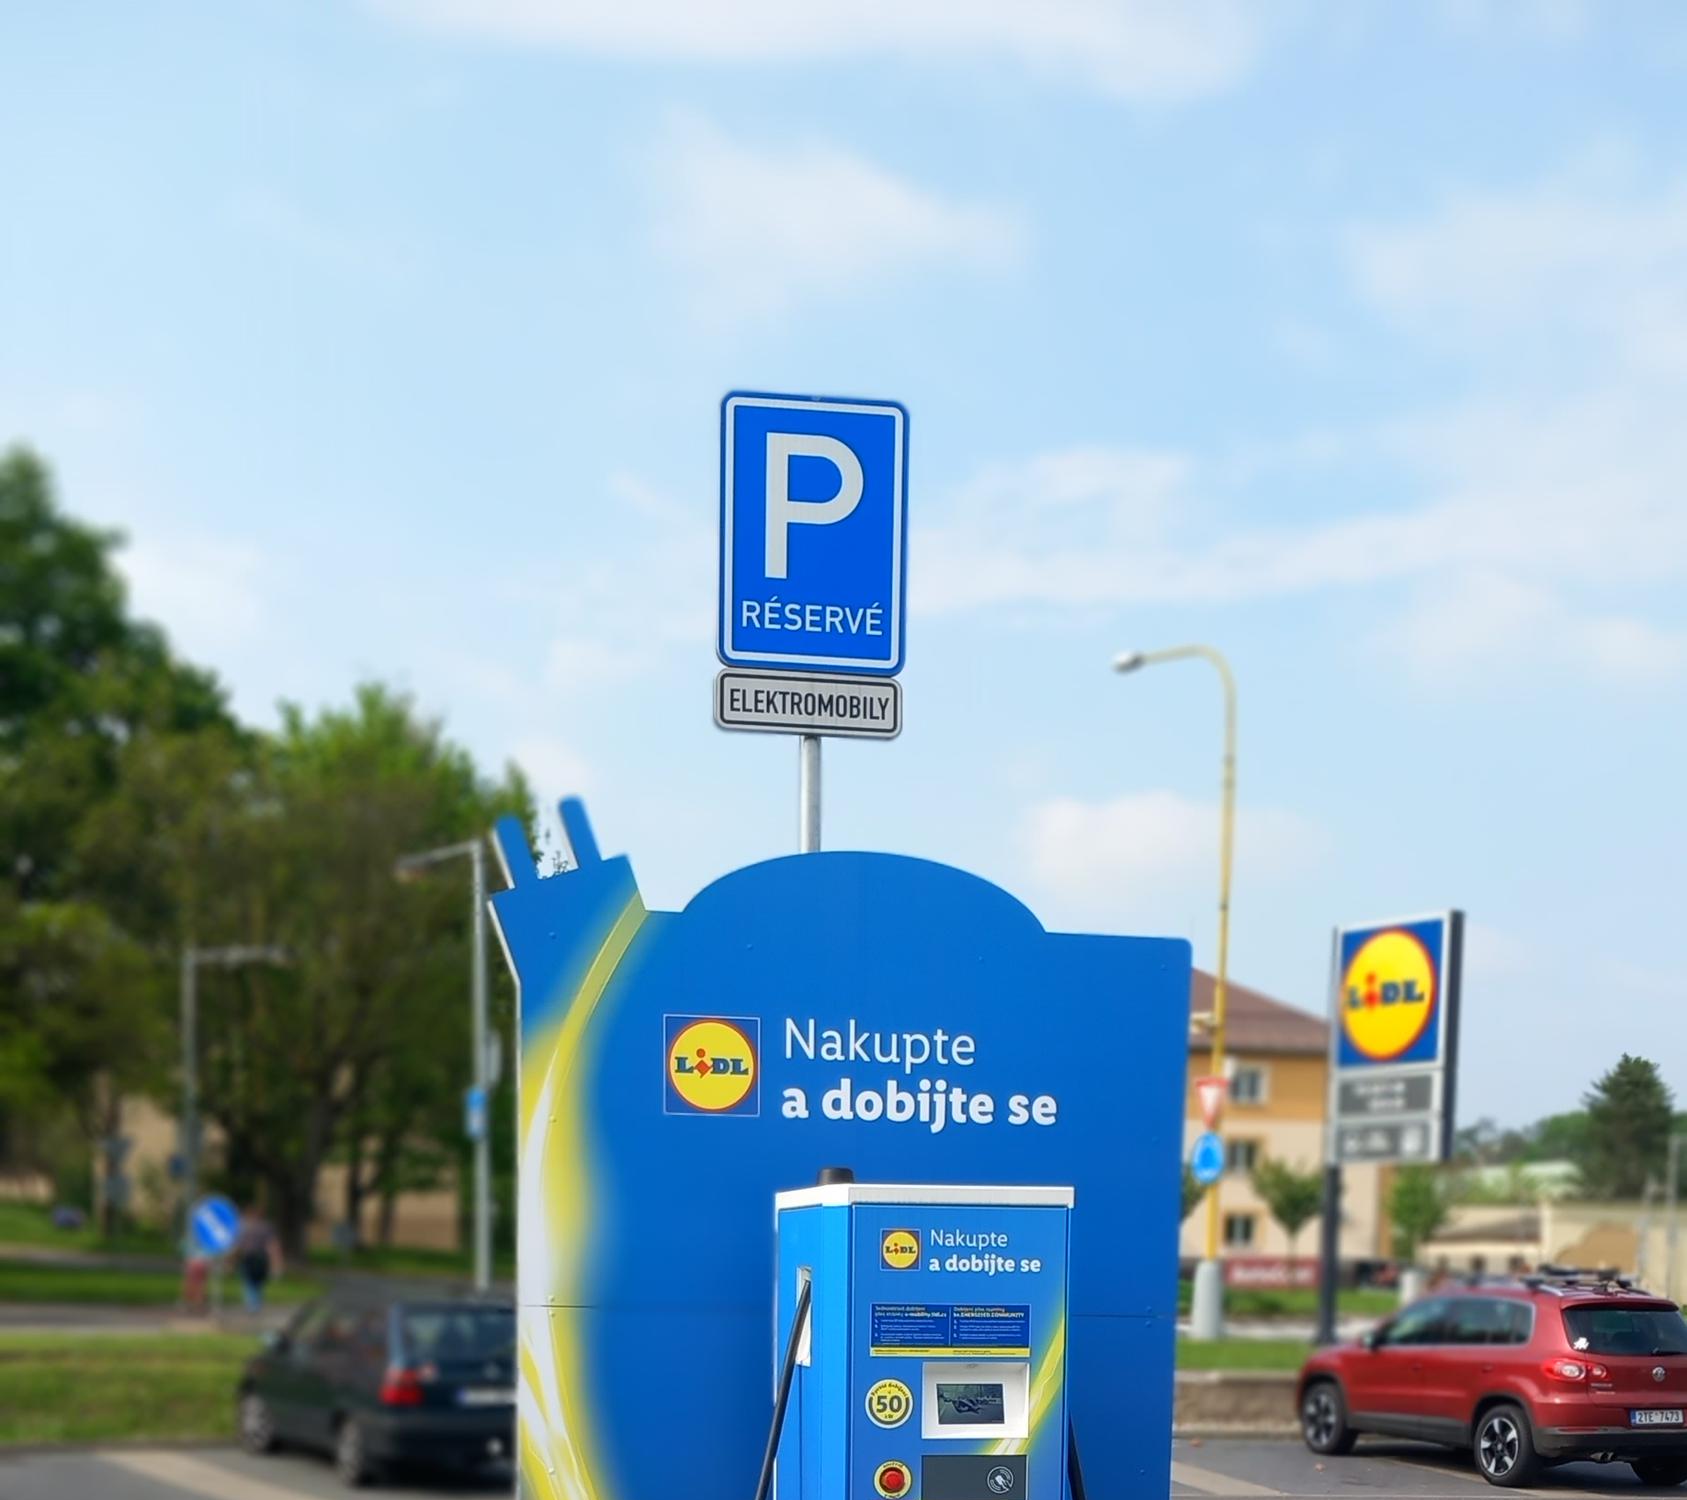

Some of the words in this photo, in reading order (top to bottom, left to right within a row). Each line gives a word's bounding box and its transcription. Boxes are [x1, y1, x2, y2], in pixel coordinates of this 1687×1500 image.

[765, 431, 864, 579] P
[742, 596, 884, 636] RÉSERVÉ
[729, 688, 891, 721] ELEKTROMOBILY
[784, 1017, 977, 1074] Nakupte
[781, 1087, 809, 1119] a
[821, 1078, 995, 1134] dobijte
[1007, 1094, 1058, 1126] se
[929, 1229, 1009, 1250] Nakupte
[928, 1258, 941, 1272] a
[944, 1253, 1016, 1276] dobijte
[1020, 1259, 1042, 1273] se
[876, 1395, 903, 1414] 50
